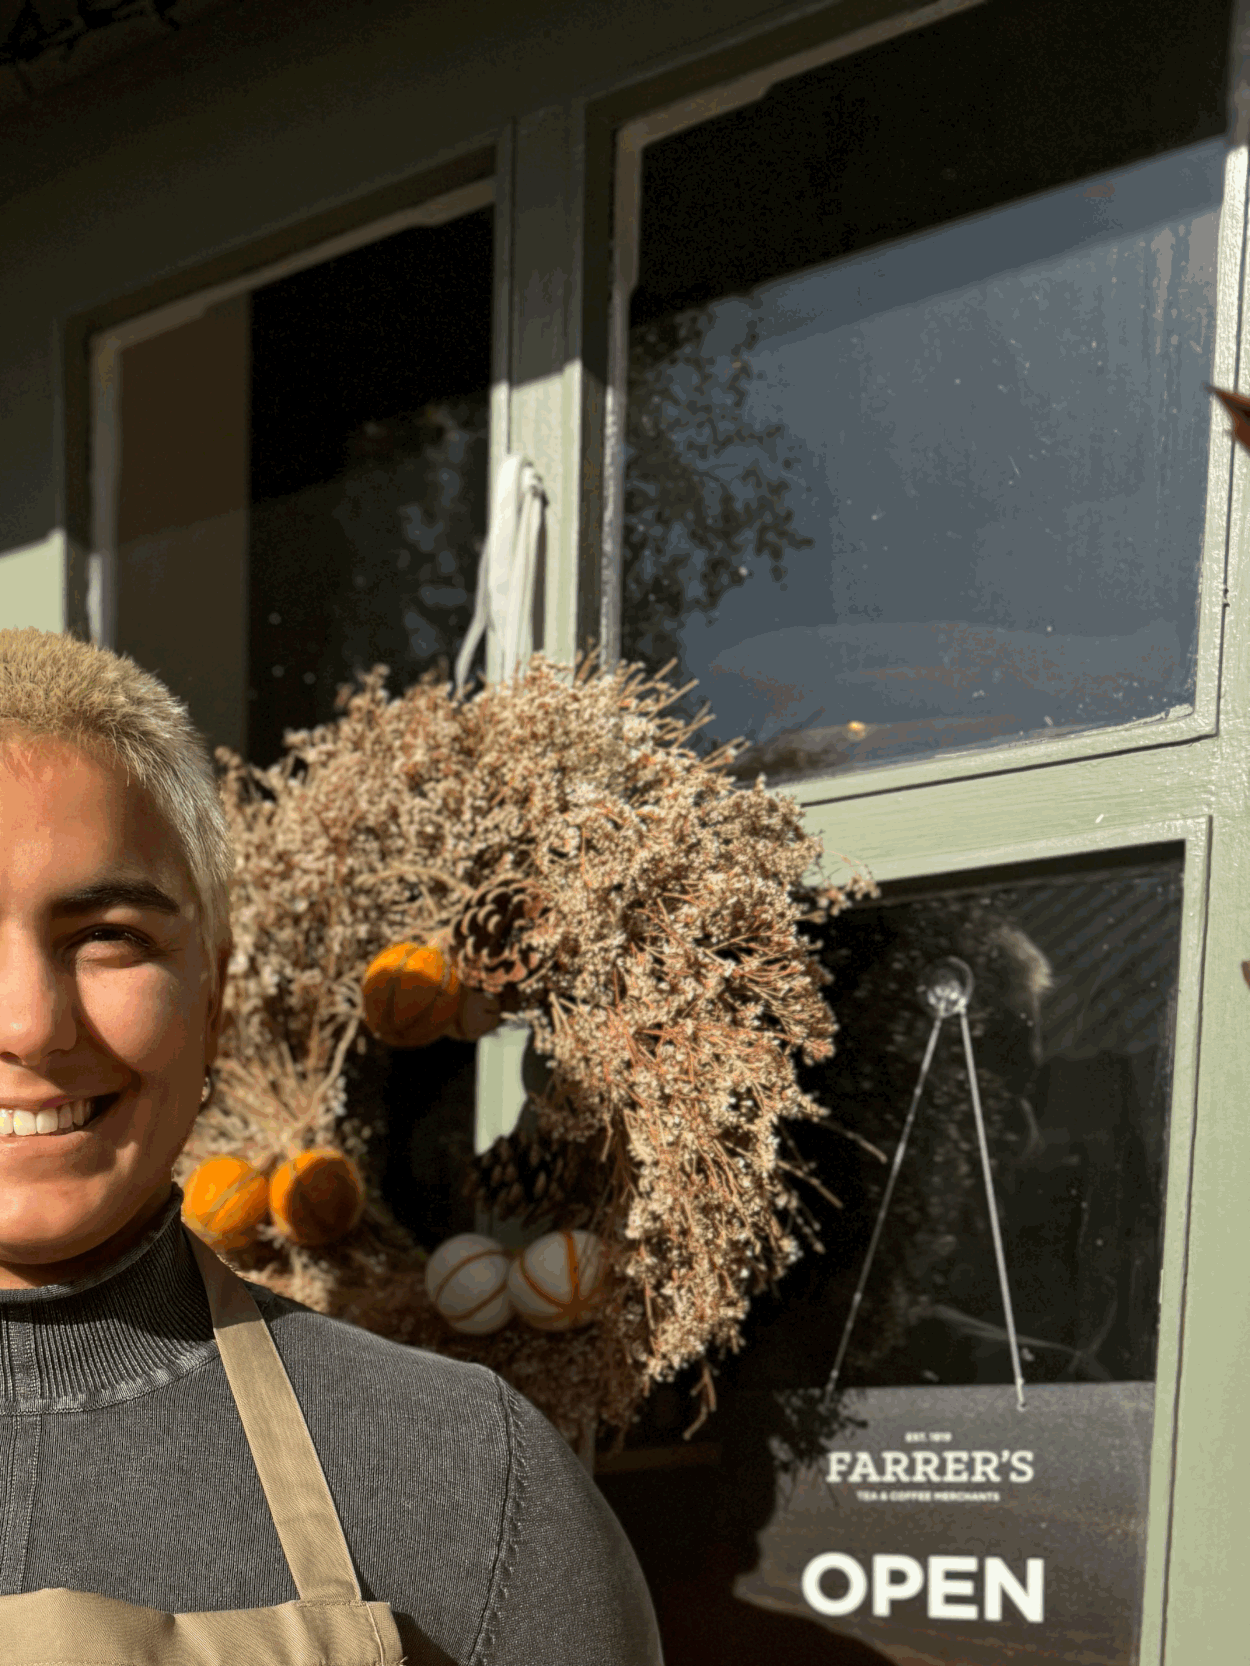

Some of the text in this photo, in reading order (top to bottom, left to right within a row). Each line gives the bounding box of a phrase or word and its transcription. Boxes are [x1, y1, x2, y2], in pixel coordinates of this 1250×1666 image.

[825, 1448, 1035, 1483] FARRER'S
[856, 1490, 878, 1502] TEA
[889, 1490, 932, 1502] COFFEE
[933, 1491, 1001, 1503] MERCHANTS
[801, 1551, 1045, 1624] OPEN
